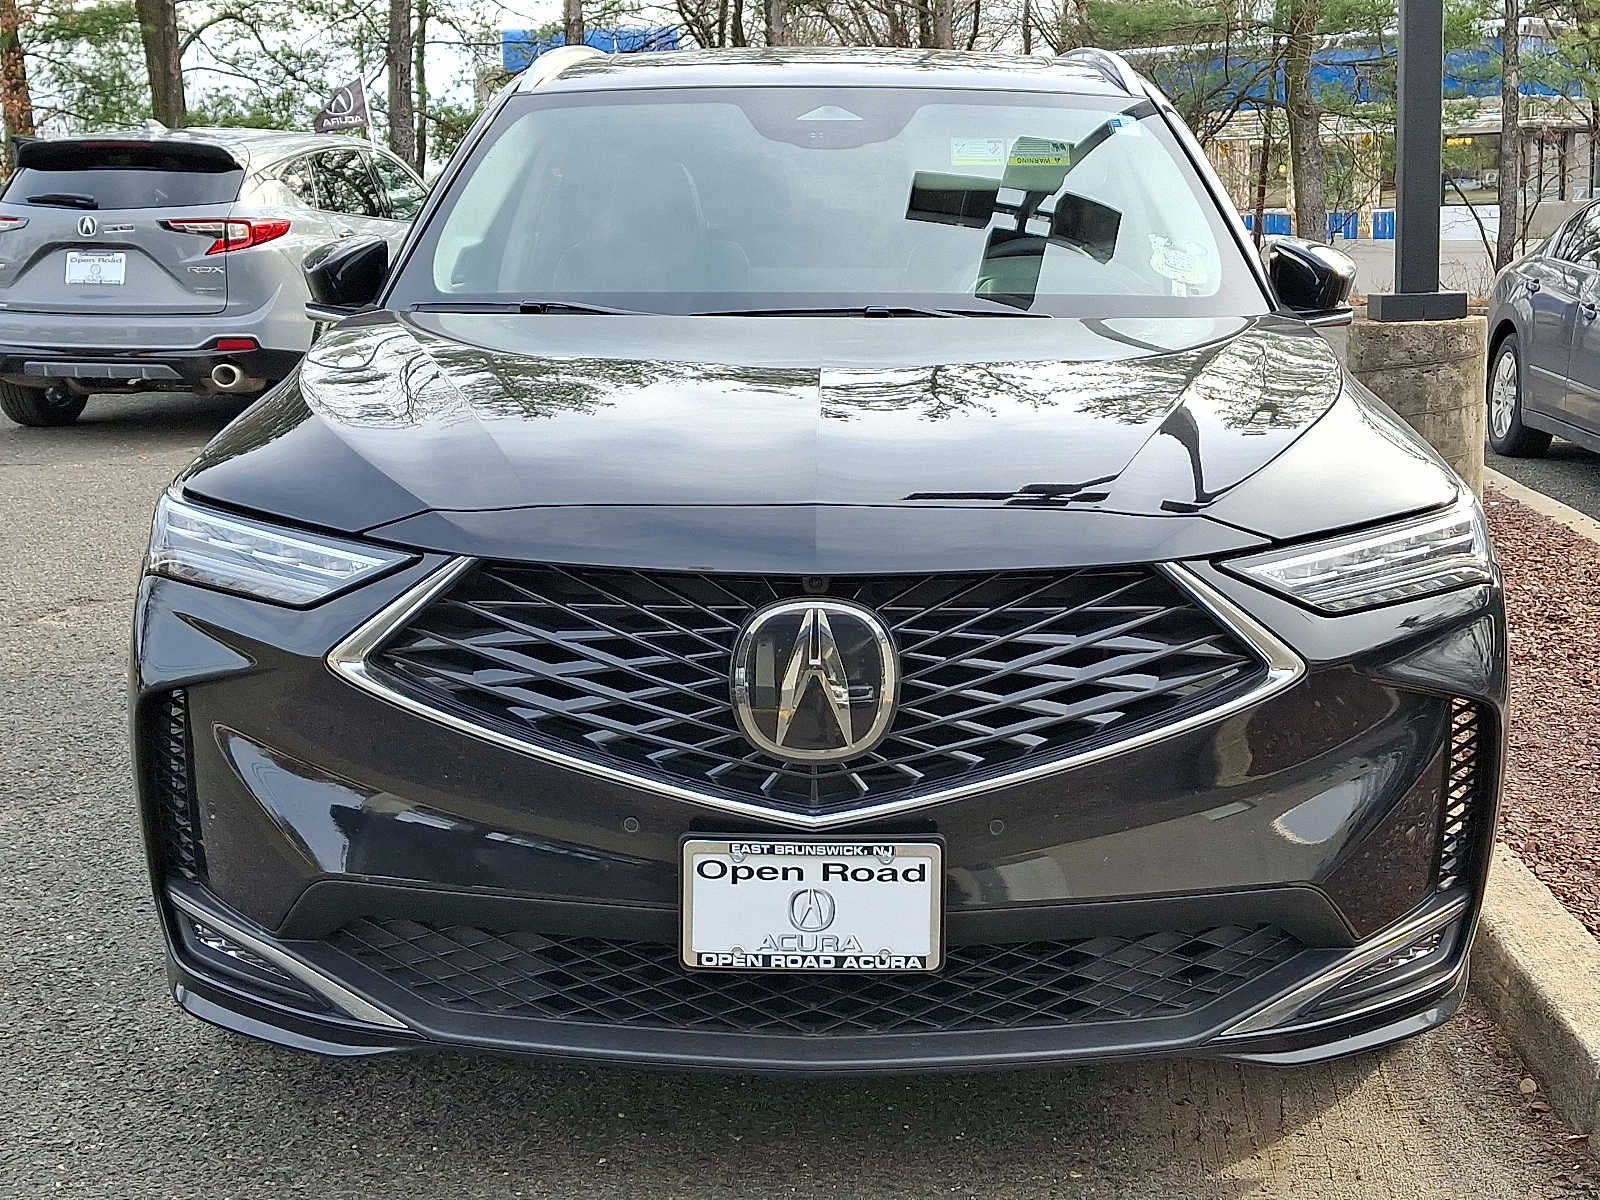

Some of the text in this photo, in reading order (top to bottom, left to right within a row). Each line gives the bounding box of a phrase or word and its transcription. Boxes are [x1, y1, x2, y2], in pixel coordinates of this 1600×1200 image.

[187, 265, 224, 274] RDX
[731, 844, 893, 856] EAST BRUNSWICK, NJ
[696, 859, 926, 885] Open Road
[756, 933, 863, 953] ACURA
[701, 953, 923, 969] OPEN ROAD ACURA
